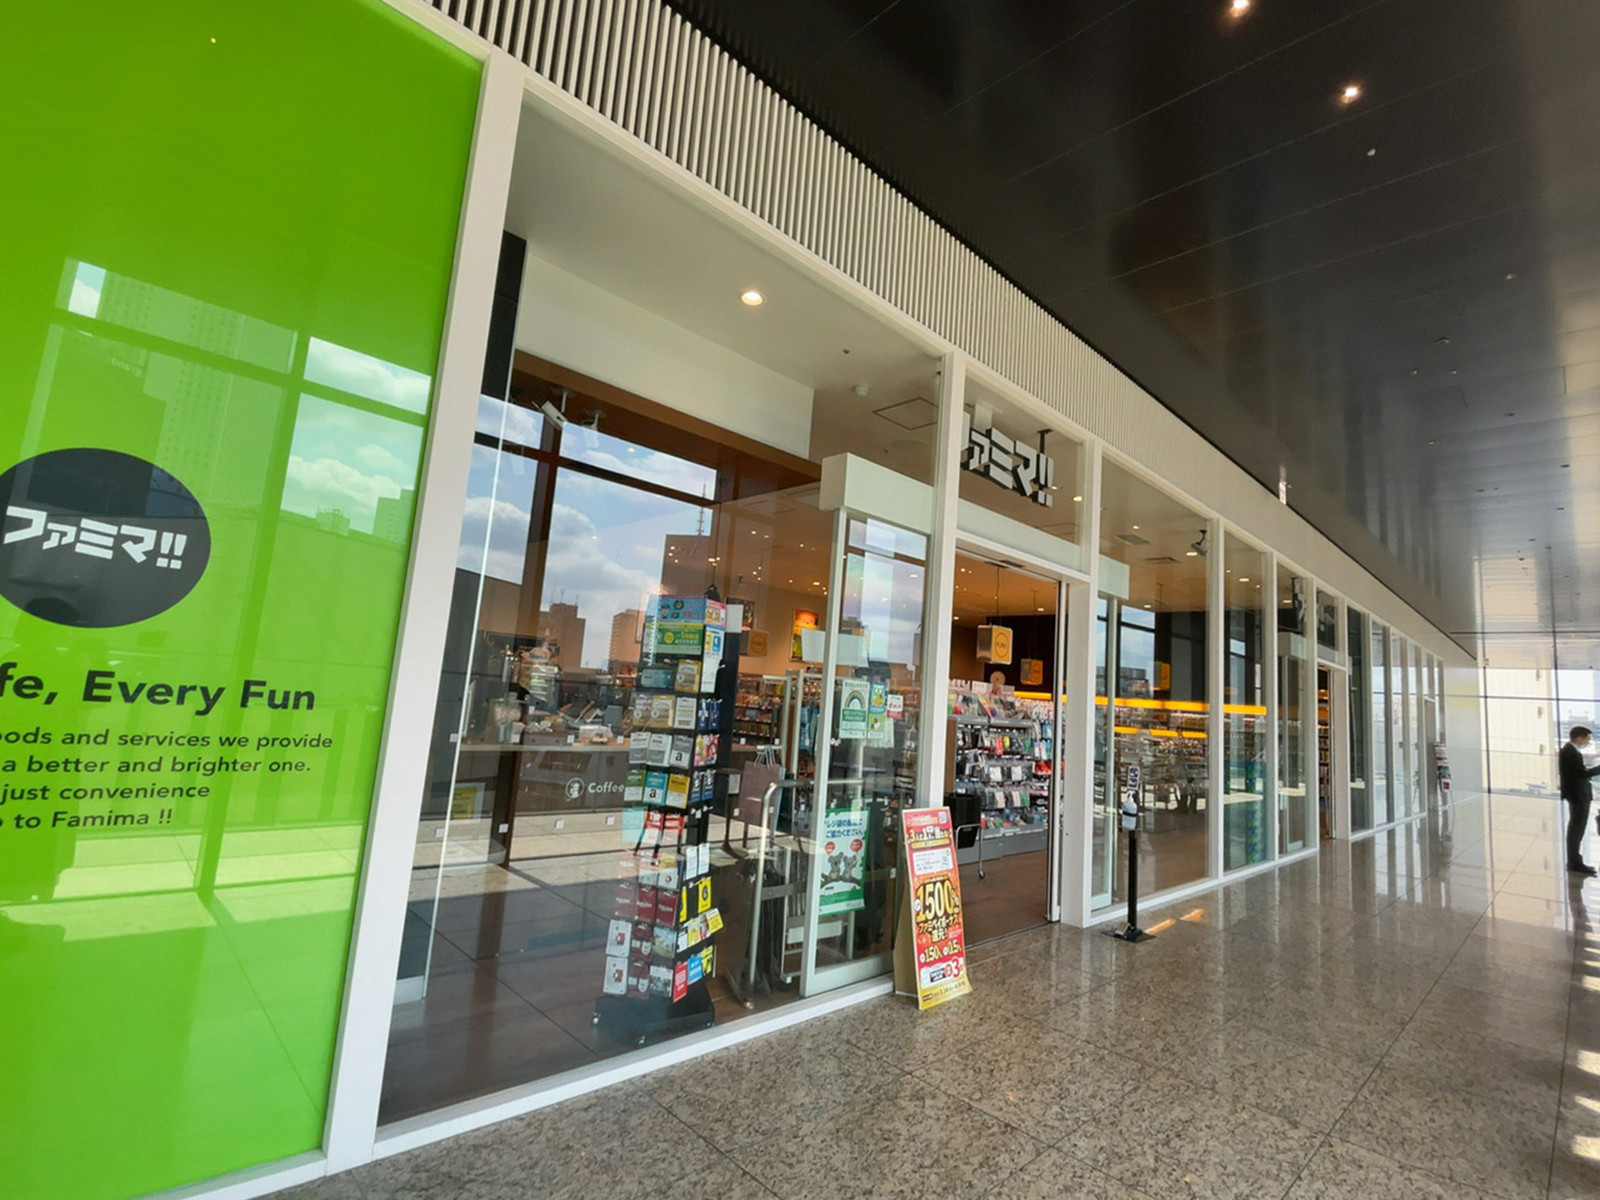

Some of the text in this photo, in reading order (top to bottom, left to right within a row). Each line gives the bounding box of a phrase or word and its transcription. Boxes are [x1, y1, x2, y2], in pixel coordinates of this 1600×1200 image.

[960, 412, 1054, 508] ァミマ!!
[3, 505, 188, 570] ファミマ!!
[82, 670, 226, 716] Every
[239, 679, 315, 711] Fun
[0, 726, 333, 751] ods and services we provide
[2, 755, 311, 777] a better and brighter one.
[0, 782, 211, 806] just convenience
[588, 781, 624, 793] Coffee
[14, 813, 41, 829] to
[51, 809, 149, 828] Famima
[158, 808, 173, 824] !!
